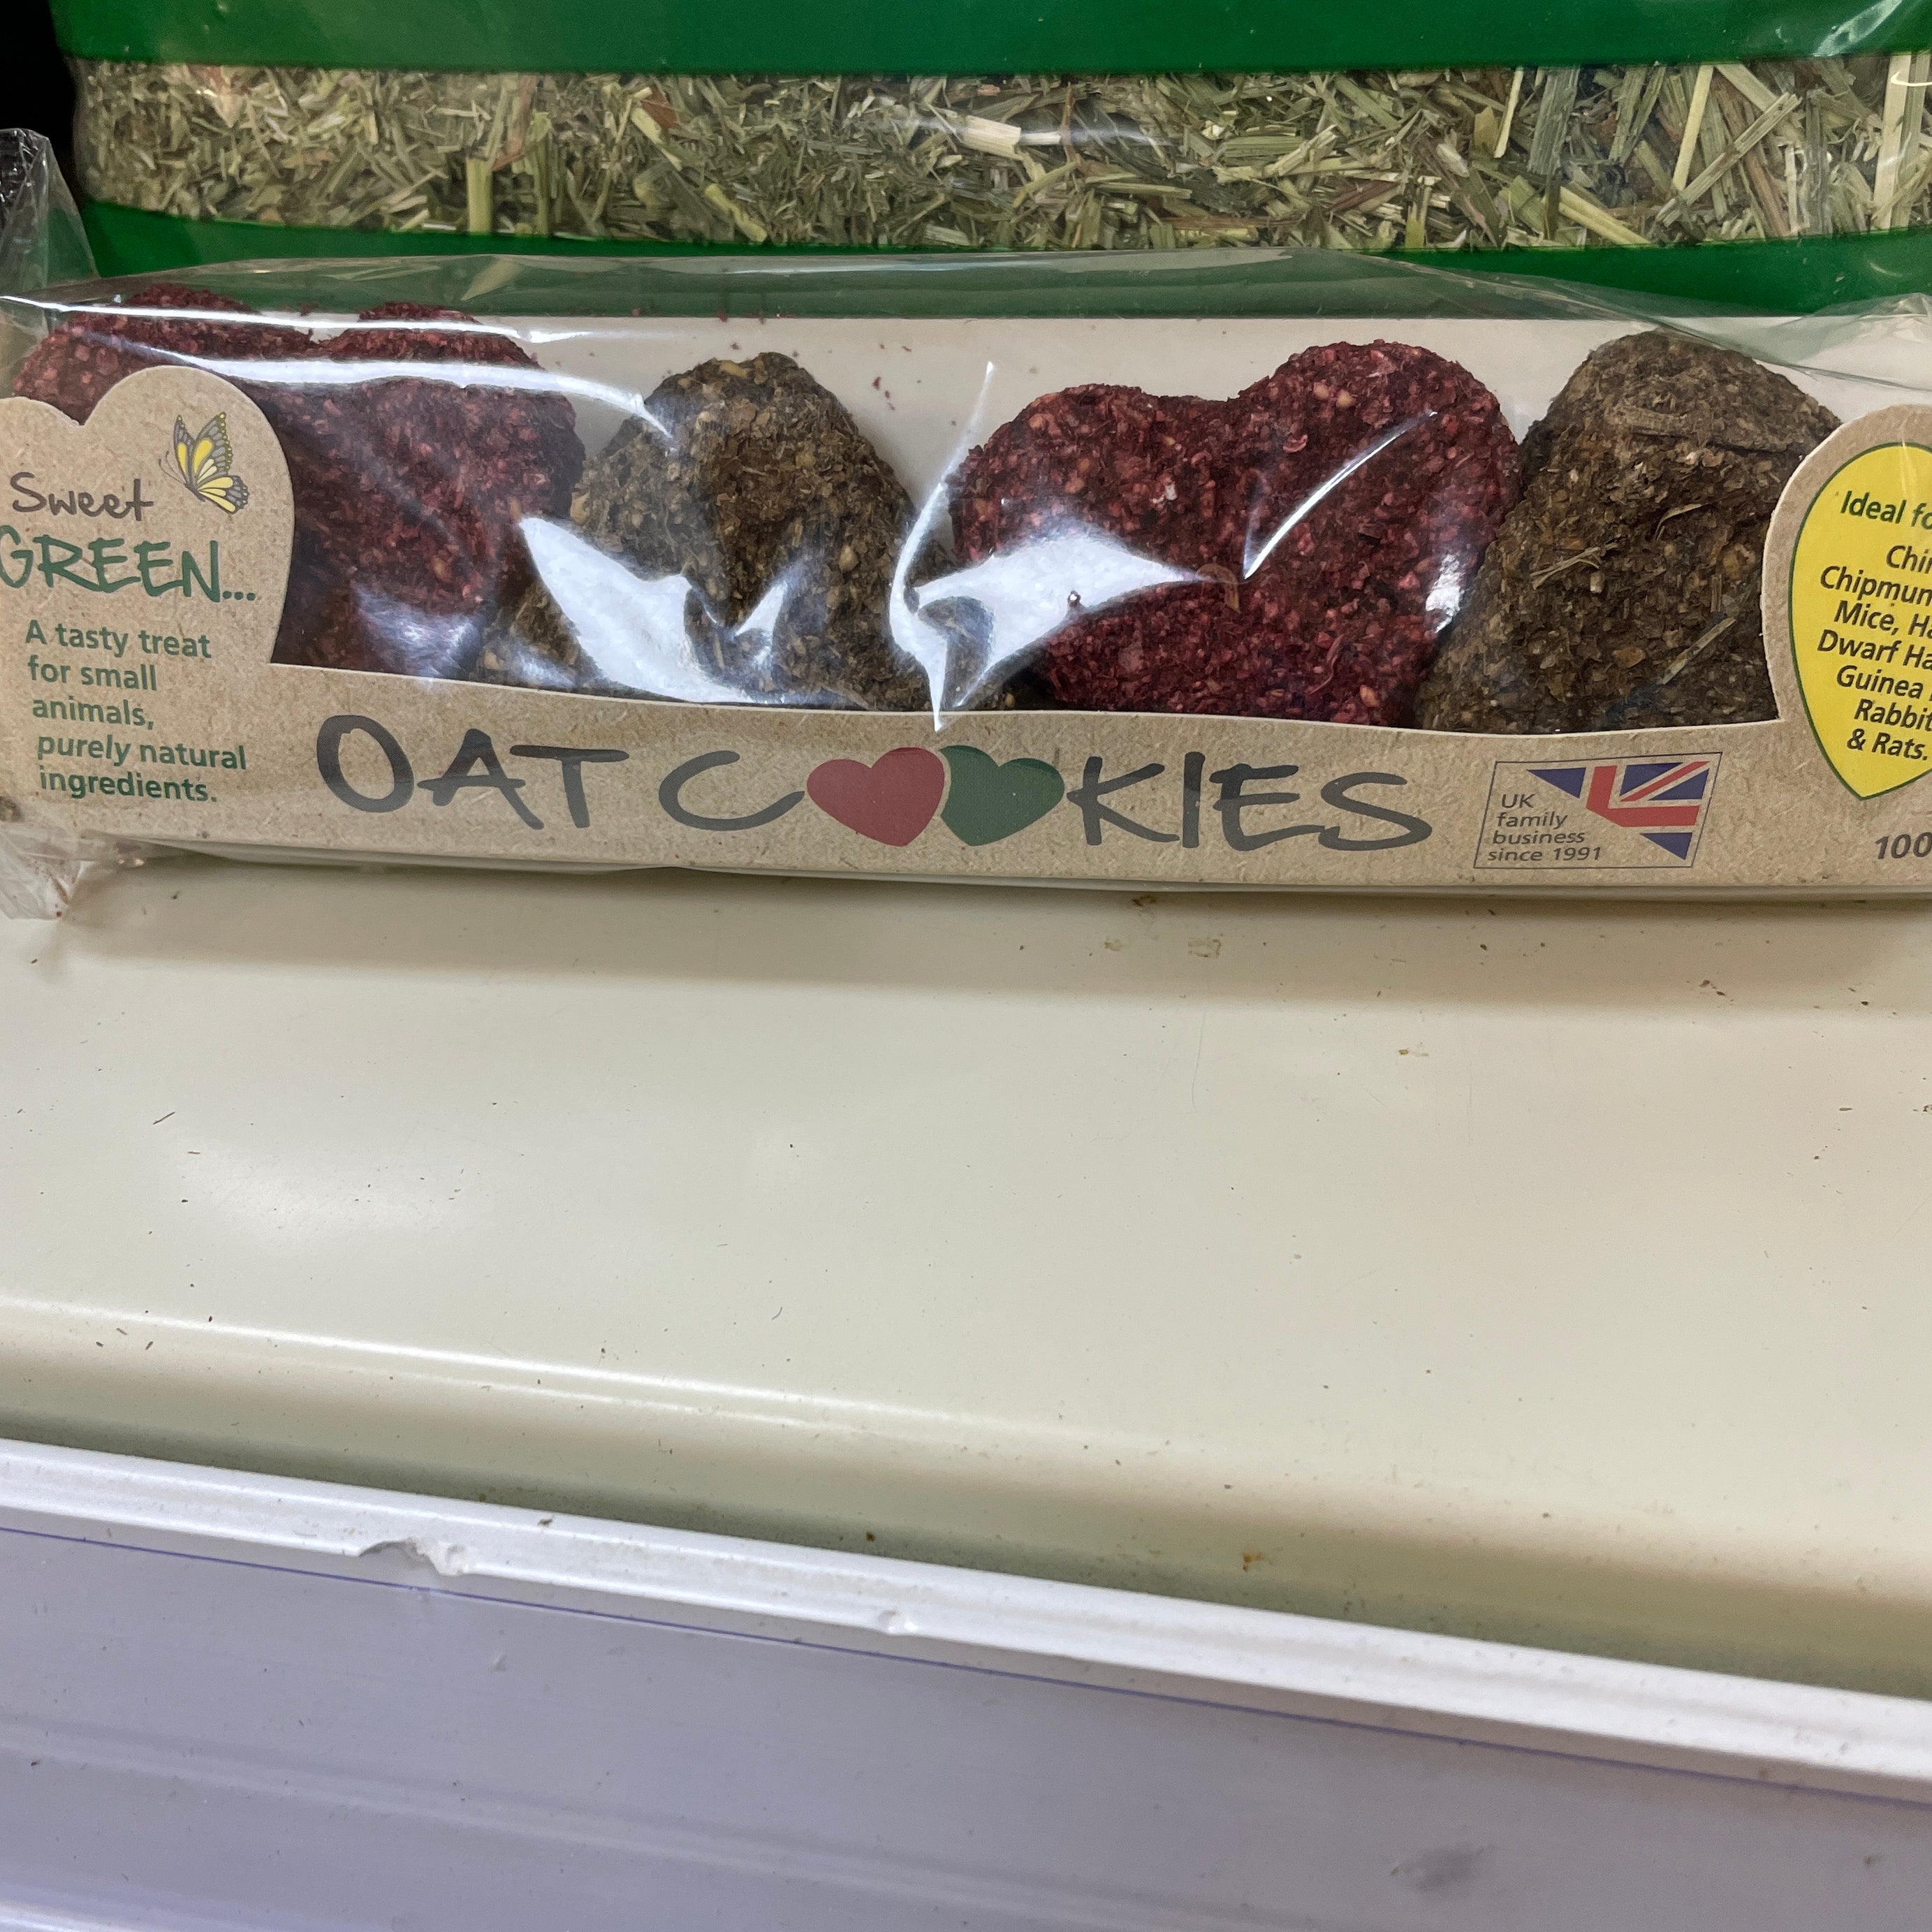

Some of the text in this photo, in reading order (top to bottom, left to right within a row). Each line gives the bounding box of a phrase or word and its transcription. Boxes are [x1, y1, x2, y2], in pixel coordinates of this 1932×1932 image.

[10, 471, 154, 521] Sweet
[1840, 490, 1907, 524] Ideal
[1834, 599, 1898, 636] Mice,
[25, 619, 212, 659] A tasty treat
[1817, 629, 1902, 664] Dwarf
[27, 654, 157, 691] for small
[1836, 665, 1924, 699] Guinea
[32, 695, 154, 730] animals,
[38, 734, 247, 770] purely natural
[1847, 728, 1928, 761] & Rats.
[40, 766, 217, 803] ingredients.
[316, 715, 629, 830] OAT
[1502, 793, 1535, 809] UK
[1492, 830, 1586, 844] business
[1497, 811, 1568, 830] family
[1487, 846, 1601, 861] since 1991
[1874, 831, 1932, 859] 100
